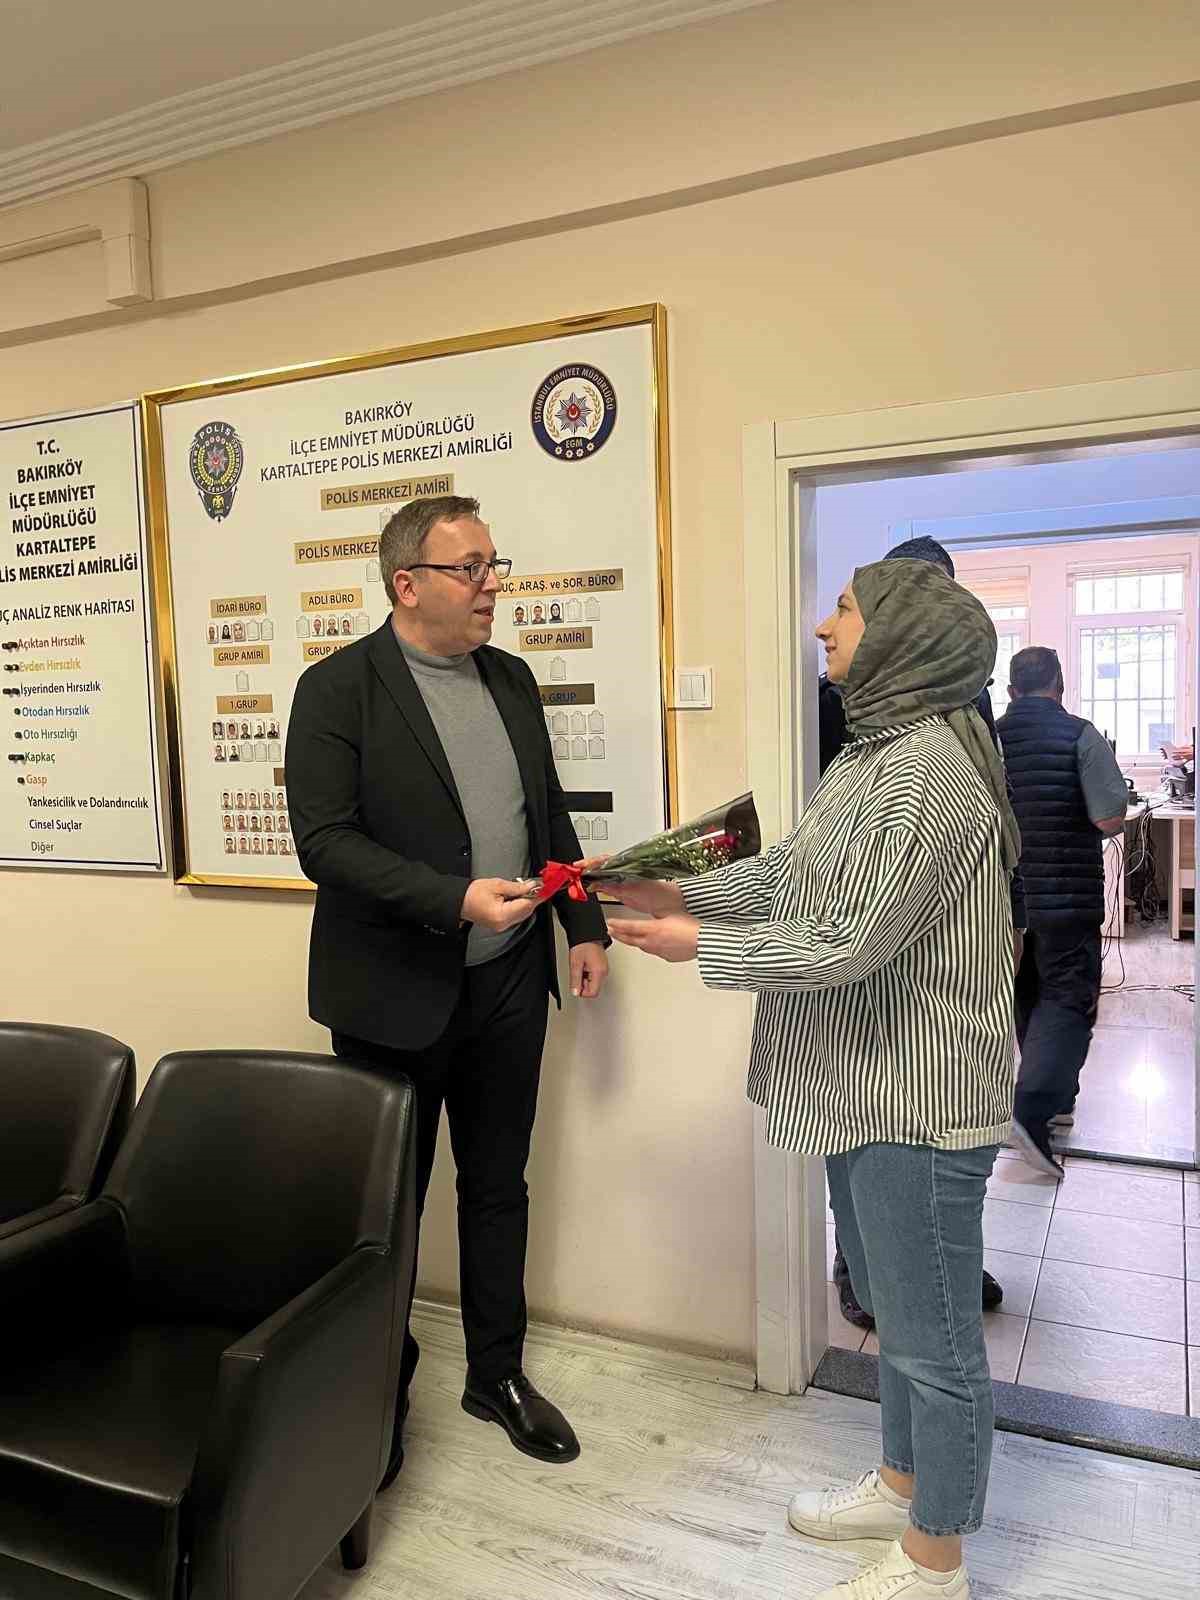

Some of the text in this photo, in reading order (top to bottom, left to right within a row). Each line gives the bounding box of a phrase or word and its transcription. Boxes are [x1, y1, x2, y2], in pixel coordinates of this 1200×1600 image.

[345, 401, 413, 425] BAKIRKÖY
[290, 413, 475, 457] İLÇE EMNİYET MÜDÜRLÜĞÜ
[36, 439, 60, 455] T.C.
[260, 431, 513, 481] KARTALTEPE POLİS MERKEZİ AMİRLİĞİ
[17, 459, 83, 484] BAKIRKÖY
[9, 484, 96, 511] İLÇE EMNİYET
[326, 476, 449, 505] POLİS MERKEZİ AMİRİ
[12, 508, 97, 533] MÜDÜRLÜĞÜ
[16, 535, 97, 558] KARTALTEPE
[298, 541, 380, 560] POLİS MERKEZ
[0, 552, 138, 583] LİS MERKEZİ AMİRLİĞİ
[550, 581, 560, 589] ve
[562, 577, 586, 589] SOR.
[12, 604, 51, 621] ANALİZ
[53, 604, 82, 617] RENK
[84, 599, 135, 616] HARİTASI
[525, 630, 585, 645] GRUP AMİRİ
[218, 651, 240, 662] GRUP
[307, 645, 331, 656] GRUP
[22, 706, 54, 717] Otodan
[230, 699, 258, 710] 1.GRUP
[23, 729, 40, 740] Oto
[24, 752, 56, 764] Kapkaç
[26, 774, 48, 787] Gasp
[27, 796, 76, 808] Yankesicilik
[78, 799, 88, 808] ve
[29, 819, 83, 832] Cinsel Suçlar
[31, 841, 55, 854] Diğer
